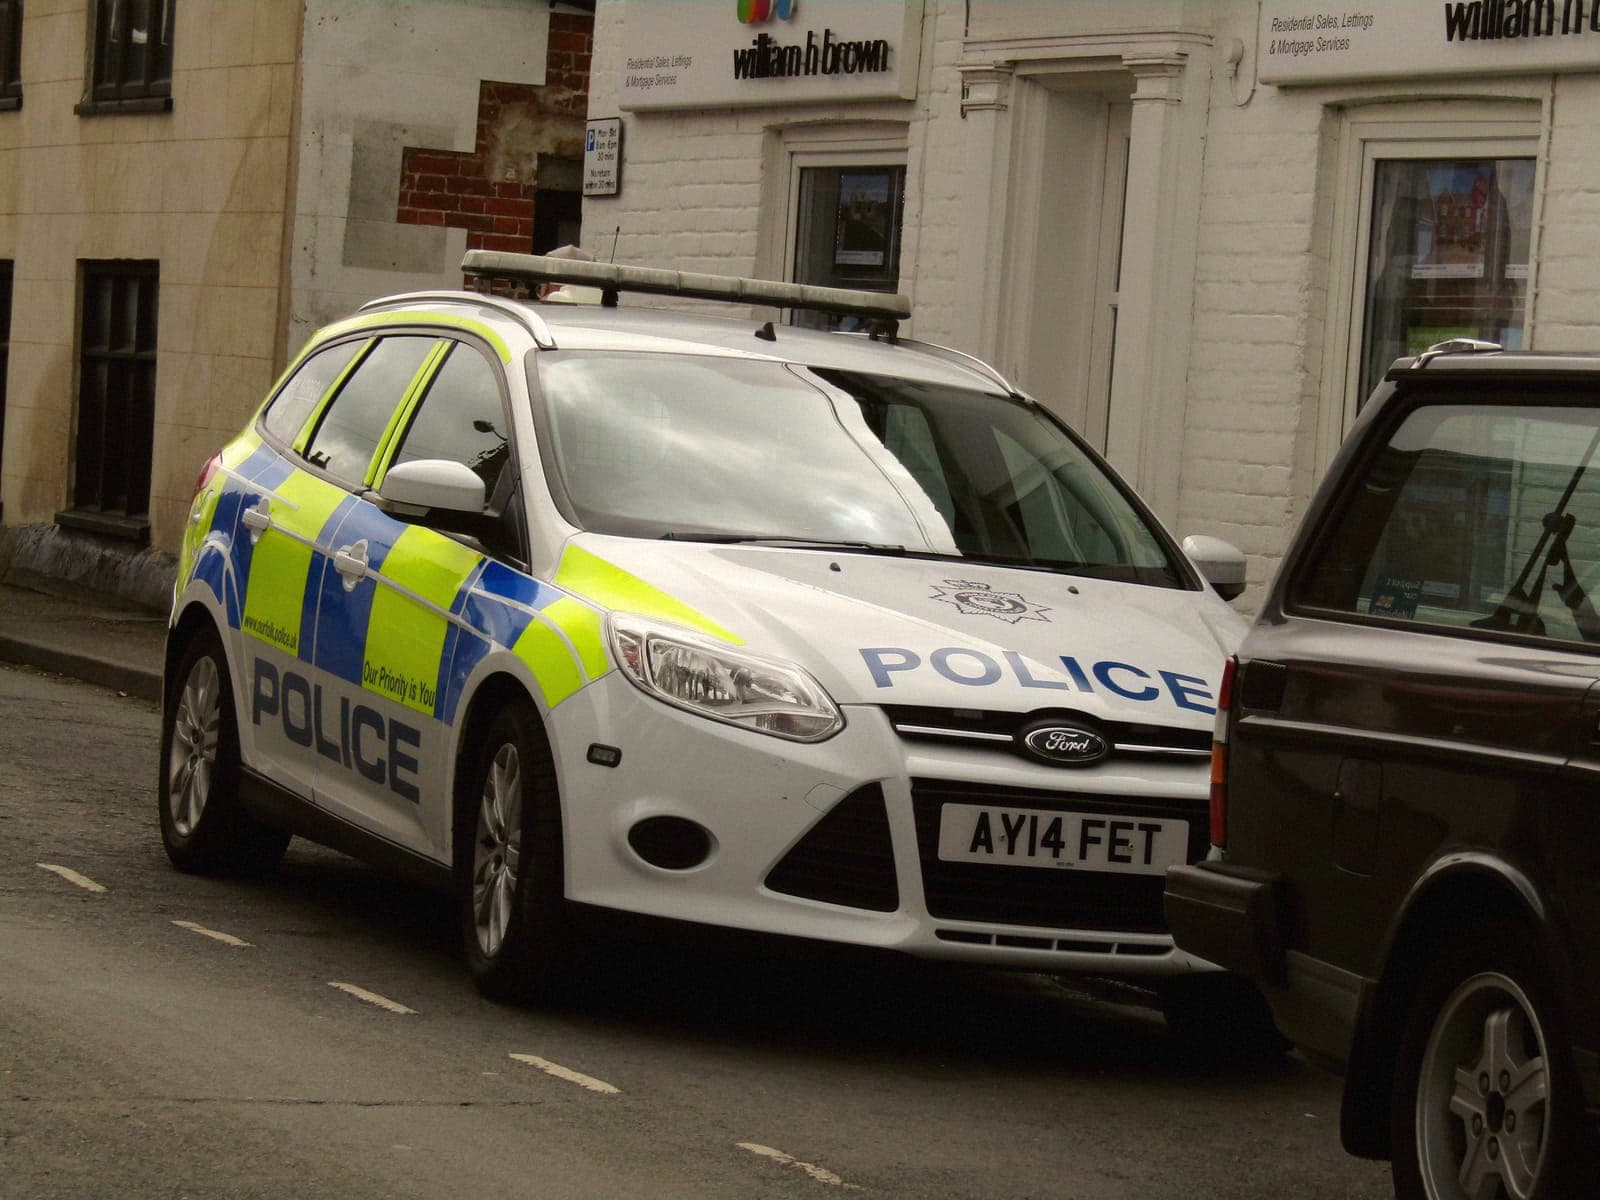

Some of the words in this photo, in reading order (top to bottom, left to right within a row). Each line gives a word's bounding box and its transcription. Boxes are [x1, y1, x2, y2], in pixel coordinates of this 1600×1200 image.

[1272, 16, 1314, 32] Residential
[1315, 14, 1339, 30] Sales,
[1342, 13, 1373, 31] Lettings
[1445, 0, 1555, 42] william
[627, 57, 654, 70] Residential
[671, 55, 692, 69] Lettings
[733, 33, 801, 79] william
[804, 30, 819, 76] h
[822, 29, 888, 75] brown
[1269, 40, 1276, 55] &
[1277, 39, 1314, 56] Mortgage
[1316, 37, 1350, 52] Services
[631, 74, 655, 90] Mortgage
[655, 73, 677, 86] Services
[363, 661, 378, 685] Our
[379, 666, 408, 702] Priority
[409, 677, 417, 701] is
[419, 680, 437, 707] You
[858, 647, 1217, 716] POLICE
[253, 656, 421, 805] POLICE
[1045, 731, 1090, 753] Ford
[969, 811, 1066, 858] AY14
[1078, 818, 1163, 866] FET
